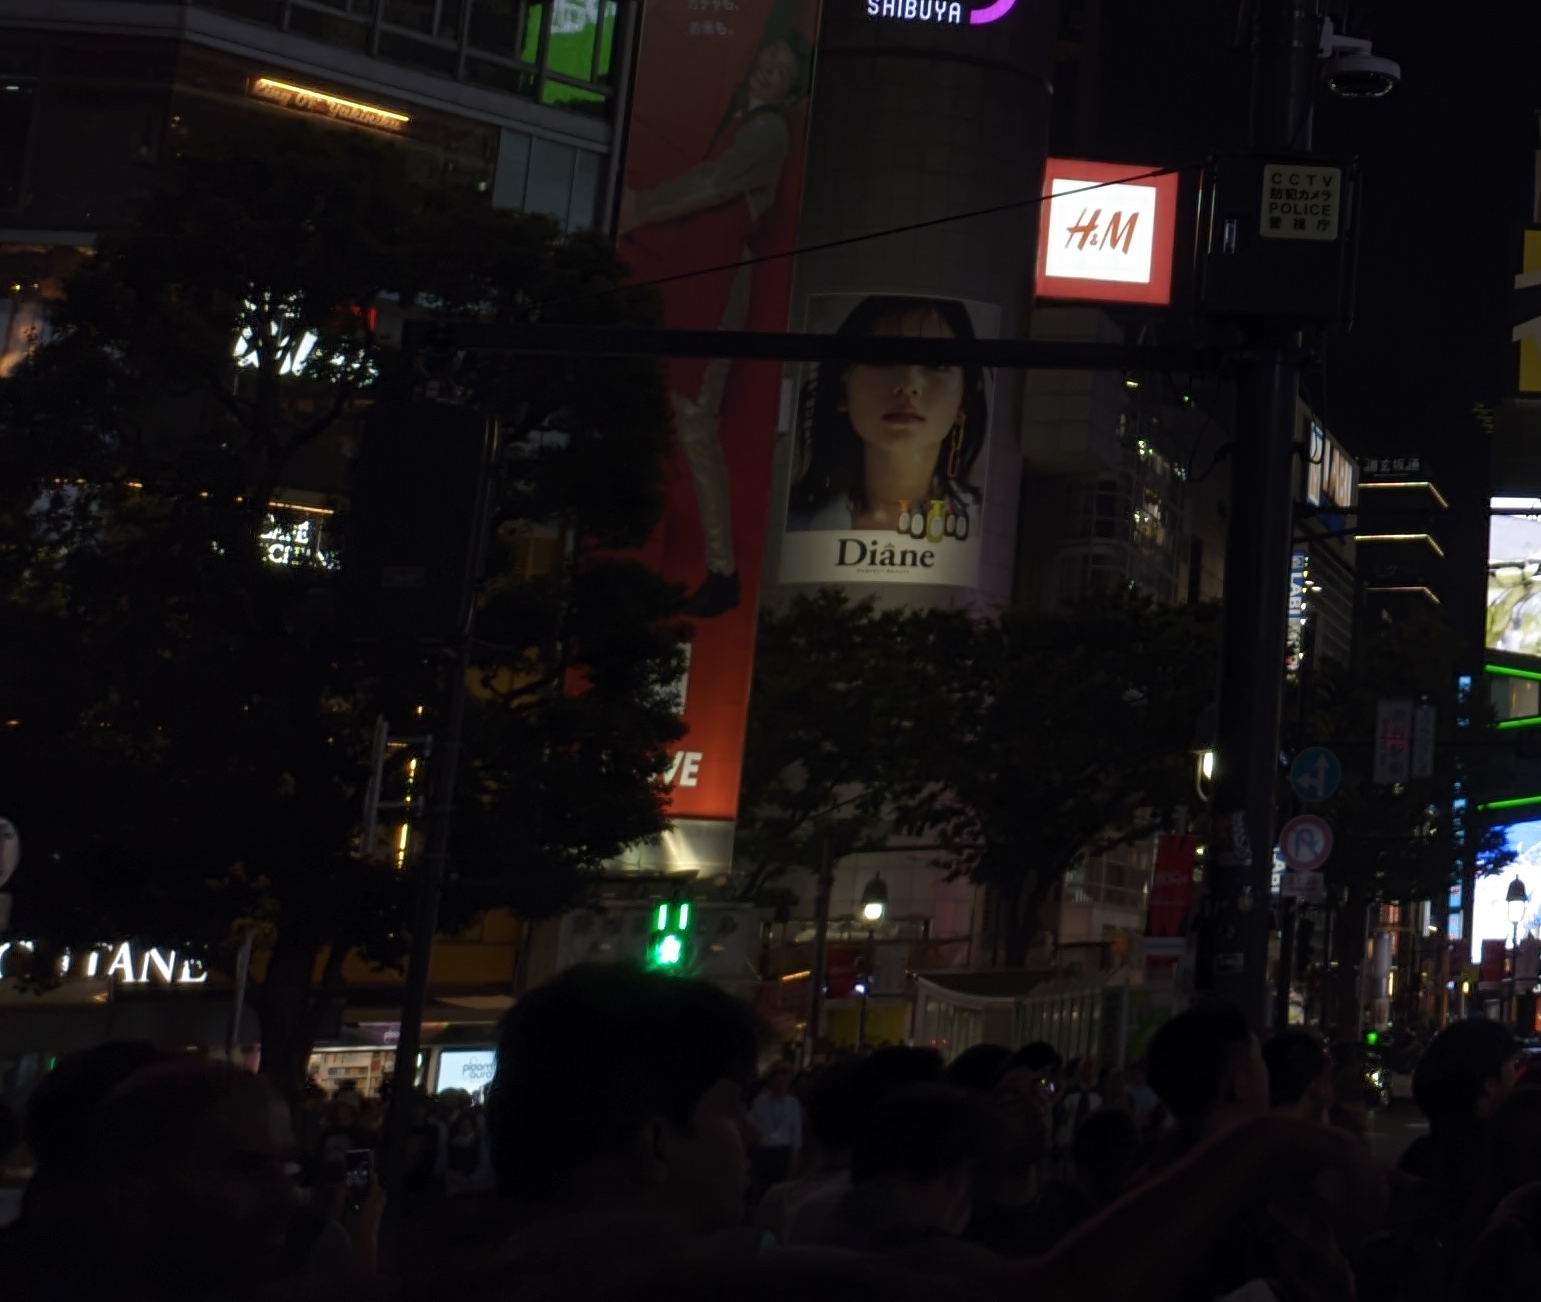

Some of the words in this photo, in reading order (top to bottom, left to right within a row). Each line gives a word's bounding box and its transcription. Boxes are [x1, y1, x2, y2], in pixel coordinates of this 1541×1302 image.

[1270, 187, 1332, 202] 防犯カメラ
[1269, 202, 1332, 217] POLICE
[1065, 208, 1140, 256] H&M
[1269, 216, 1330, 232] 警視庁
[835, 538, 936, 569] Diâne
